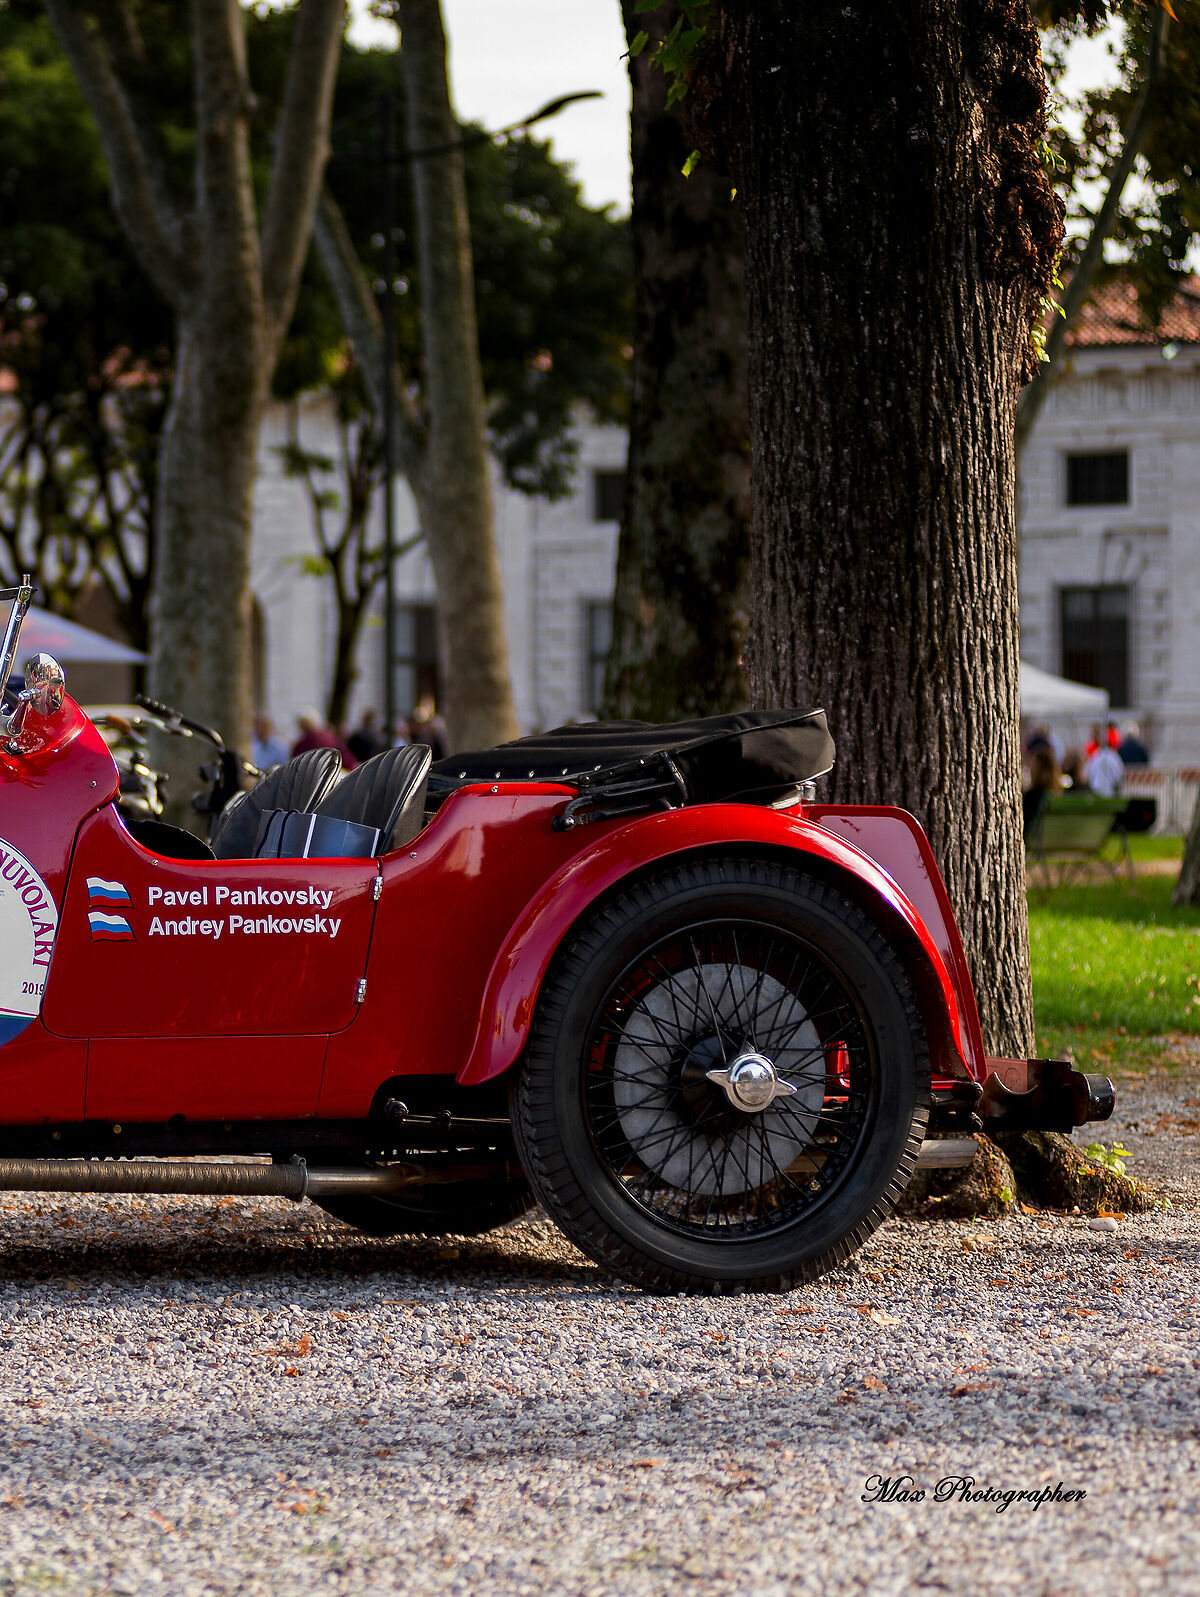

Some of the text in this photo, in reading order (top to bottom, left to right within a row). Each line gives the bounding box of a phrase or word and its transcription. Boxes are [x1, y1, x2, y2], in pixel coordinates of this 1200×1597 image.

[148, 886, 333, 910] Pavel Pankovsky
[148, 914, 341, 939] Andrey Pankovsky
[22, 981, 45, 996] 2019
